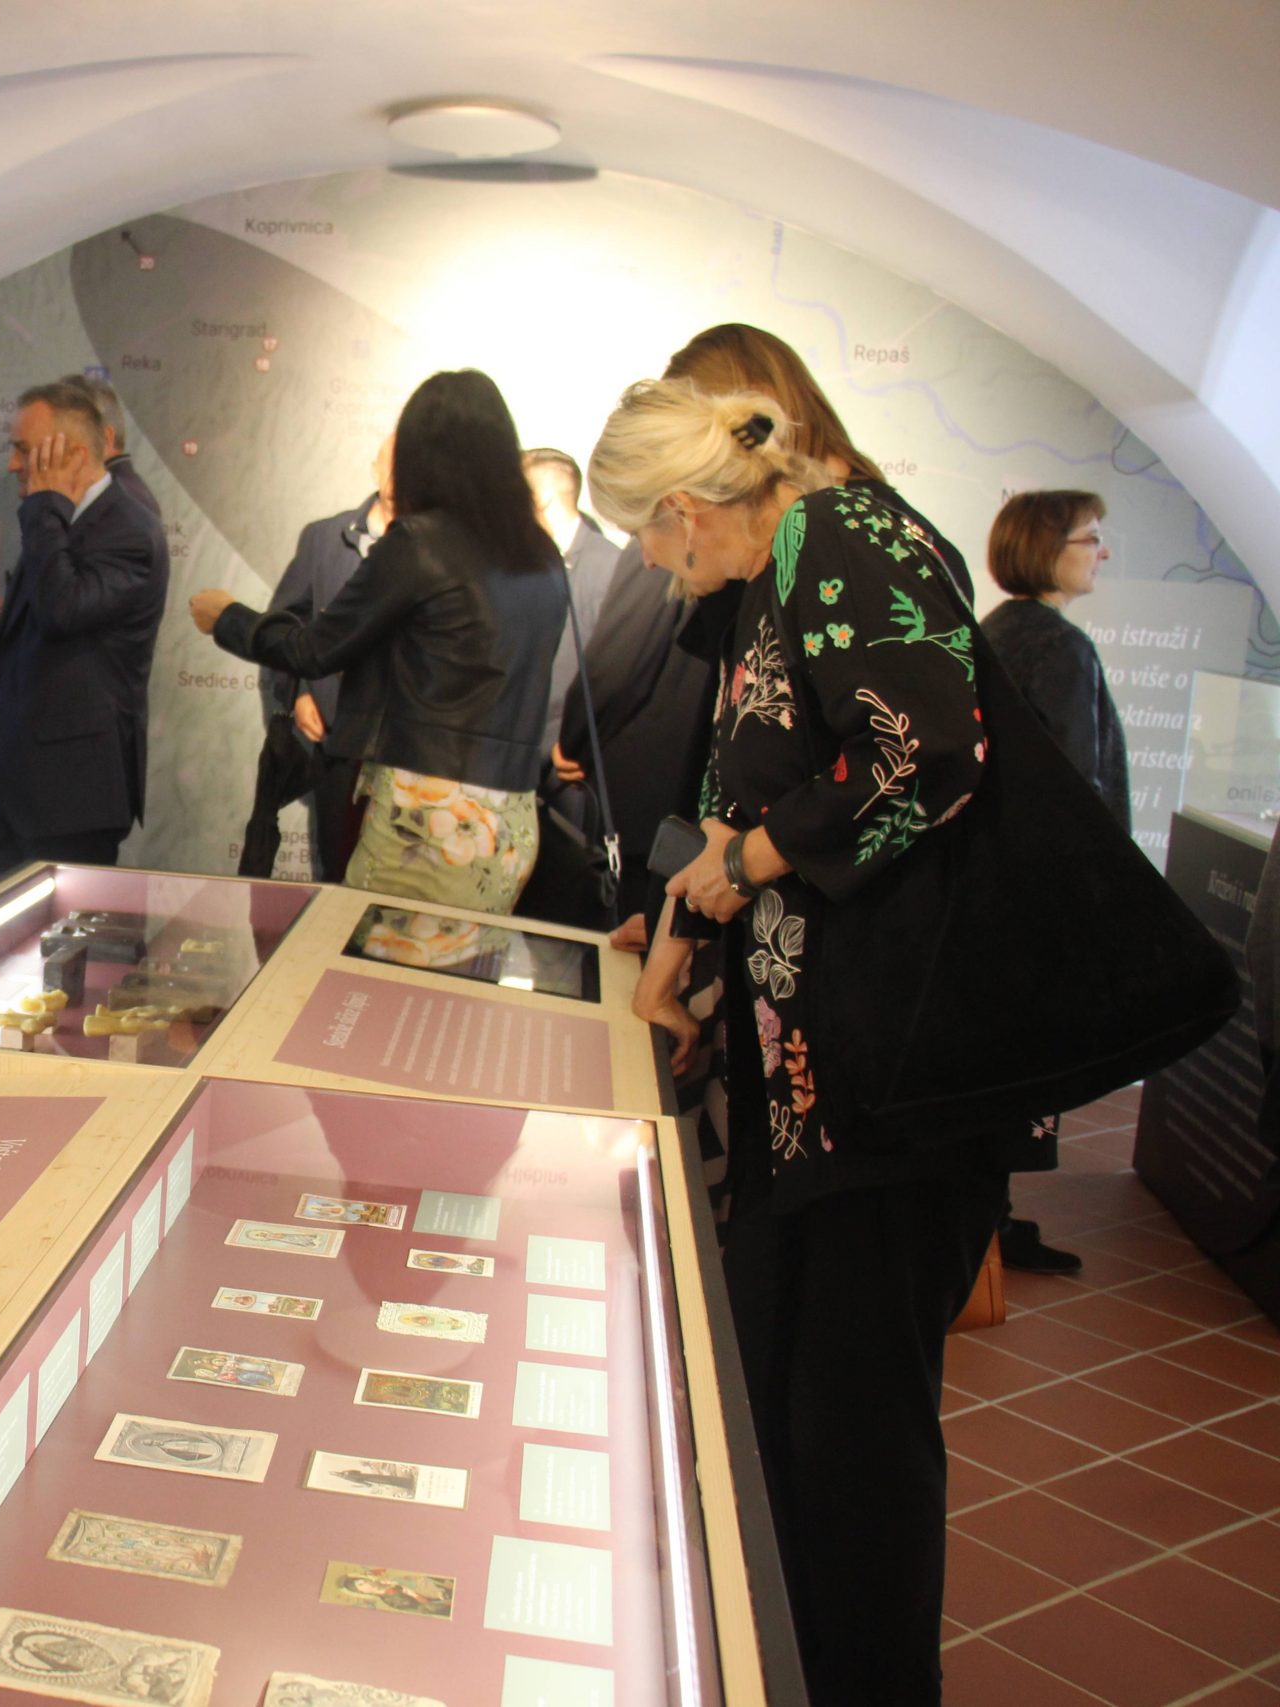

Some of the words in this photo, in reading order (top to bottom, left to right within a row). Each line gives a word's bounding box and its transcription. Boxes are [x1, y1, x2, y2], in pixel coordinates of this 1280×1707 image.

[244, 218, 334, 237] Koprivnica
[121, 353, 162, 372] Reka
[853, 343, 910, 365] Repaš
[1121, 623, 1188, 649] istraži
[1192, 627, 1202, 650] i
[177, 670, 239, 689] Sredice
[1131, 665, 1170, 689] više
[1174, 673, 1189, 690] o
